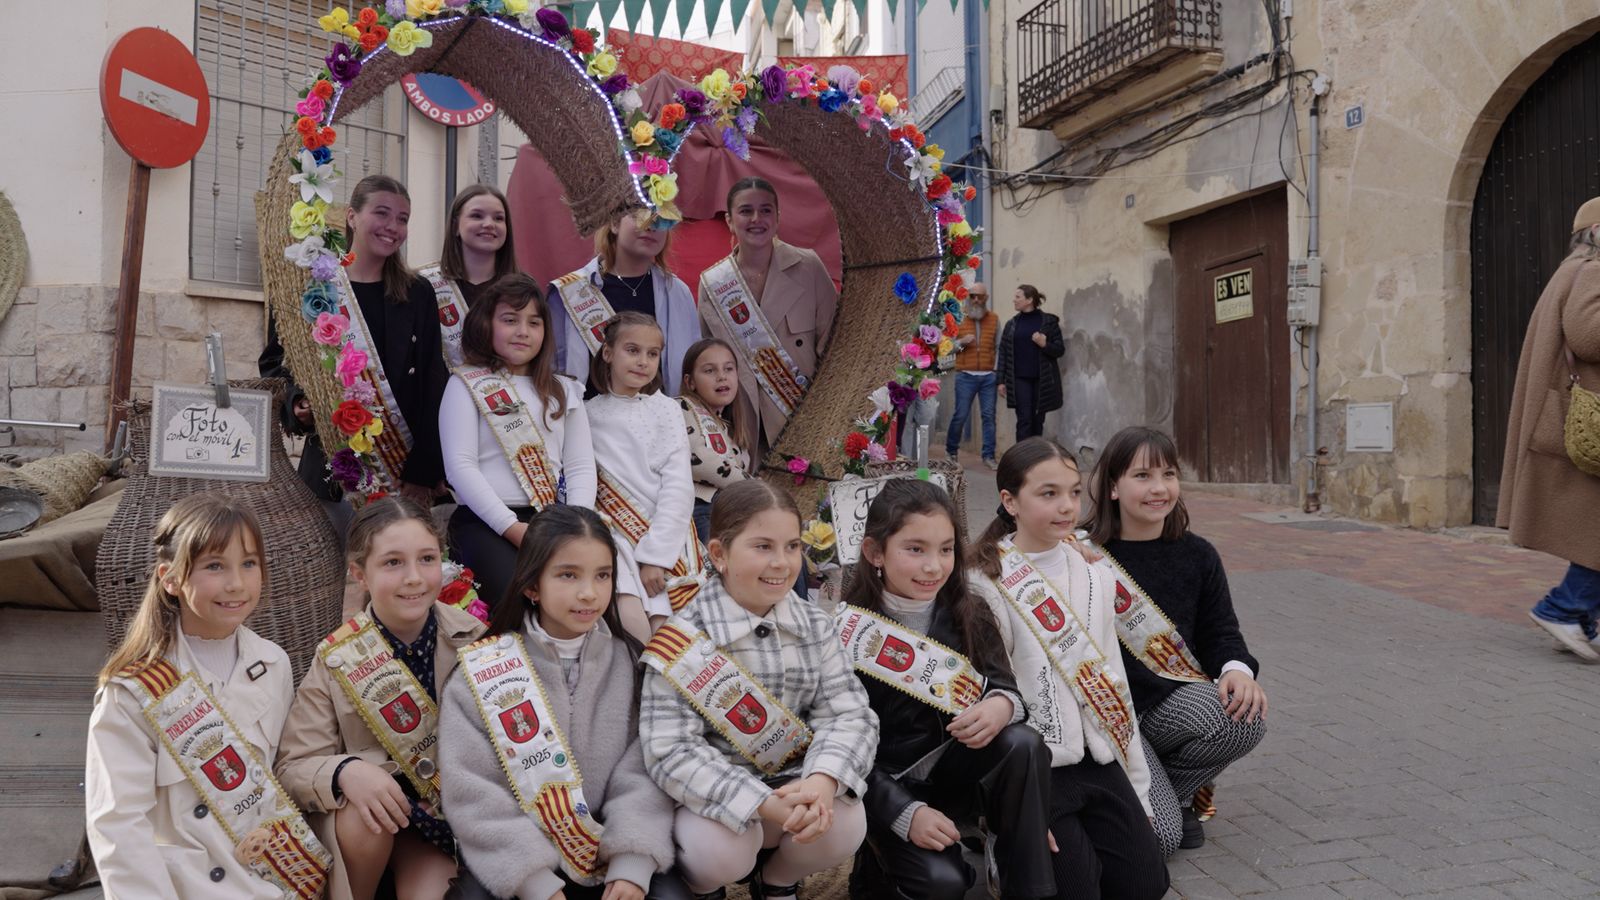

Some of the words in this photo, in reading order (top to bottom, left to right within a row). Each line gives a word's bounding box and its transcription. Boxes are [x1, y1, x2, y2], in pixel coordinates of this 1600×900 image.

[405, 82, 451, 123] AMBOS
[456, 98, 494, 125] LADO
[1349, 110, 1360, 124] 12
[1217, 279, 1228, 299] ES
[1230, 273, 1250, 296] VEN
[449, 331, 462, 342] 202
[180, 407, 228, 439] Foto
[504, 418, 524, 433] 2025
[166, 432, 182, 441] con
[188, 431, 200, 442] el
[202, 428, 235, 446] móvil
[231, 438, 251, 459] 1€
[852, 521, 866, 532] co
[856, 620, 876, 642] PATRONALS
[1126, 611, 1146, 631] 2025
[1058, 634, 1078, 653] 2025
[347, 650, 394, 685] TORREBLANCA
[473, 657, 524, 685] TORREBLANCA
[686, 654, 728, 695] TORREBLANCA
[919, 657, 938, 685] 2025
[361, 680, 375, 699] FESTES
[373, 669, 402, 684] PATRONALS
[482, 685, 499, 701] FESTES
[499, 676, 530, 687] PATRONALS
[704, 687, 715, 708] FESTES
[713, 671, 740, 689] PATRONALS
[165, 699, 215, 742] TORREBLANCA
[180, 736, 195, 756] FESTES
[194, 720, 224, 739] PATRONALS
[410, 732, 437, 755] 2025
[761, 728, 785, 753] 2025
[521, 747, 552, 770] 2025
[233, 790, 264, 816] 2025
